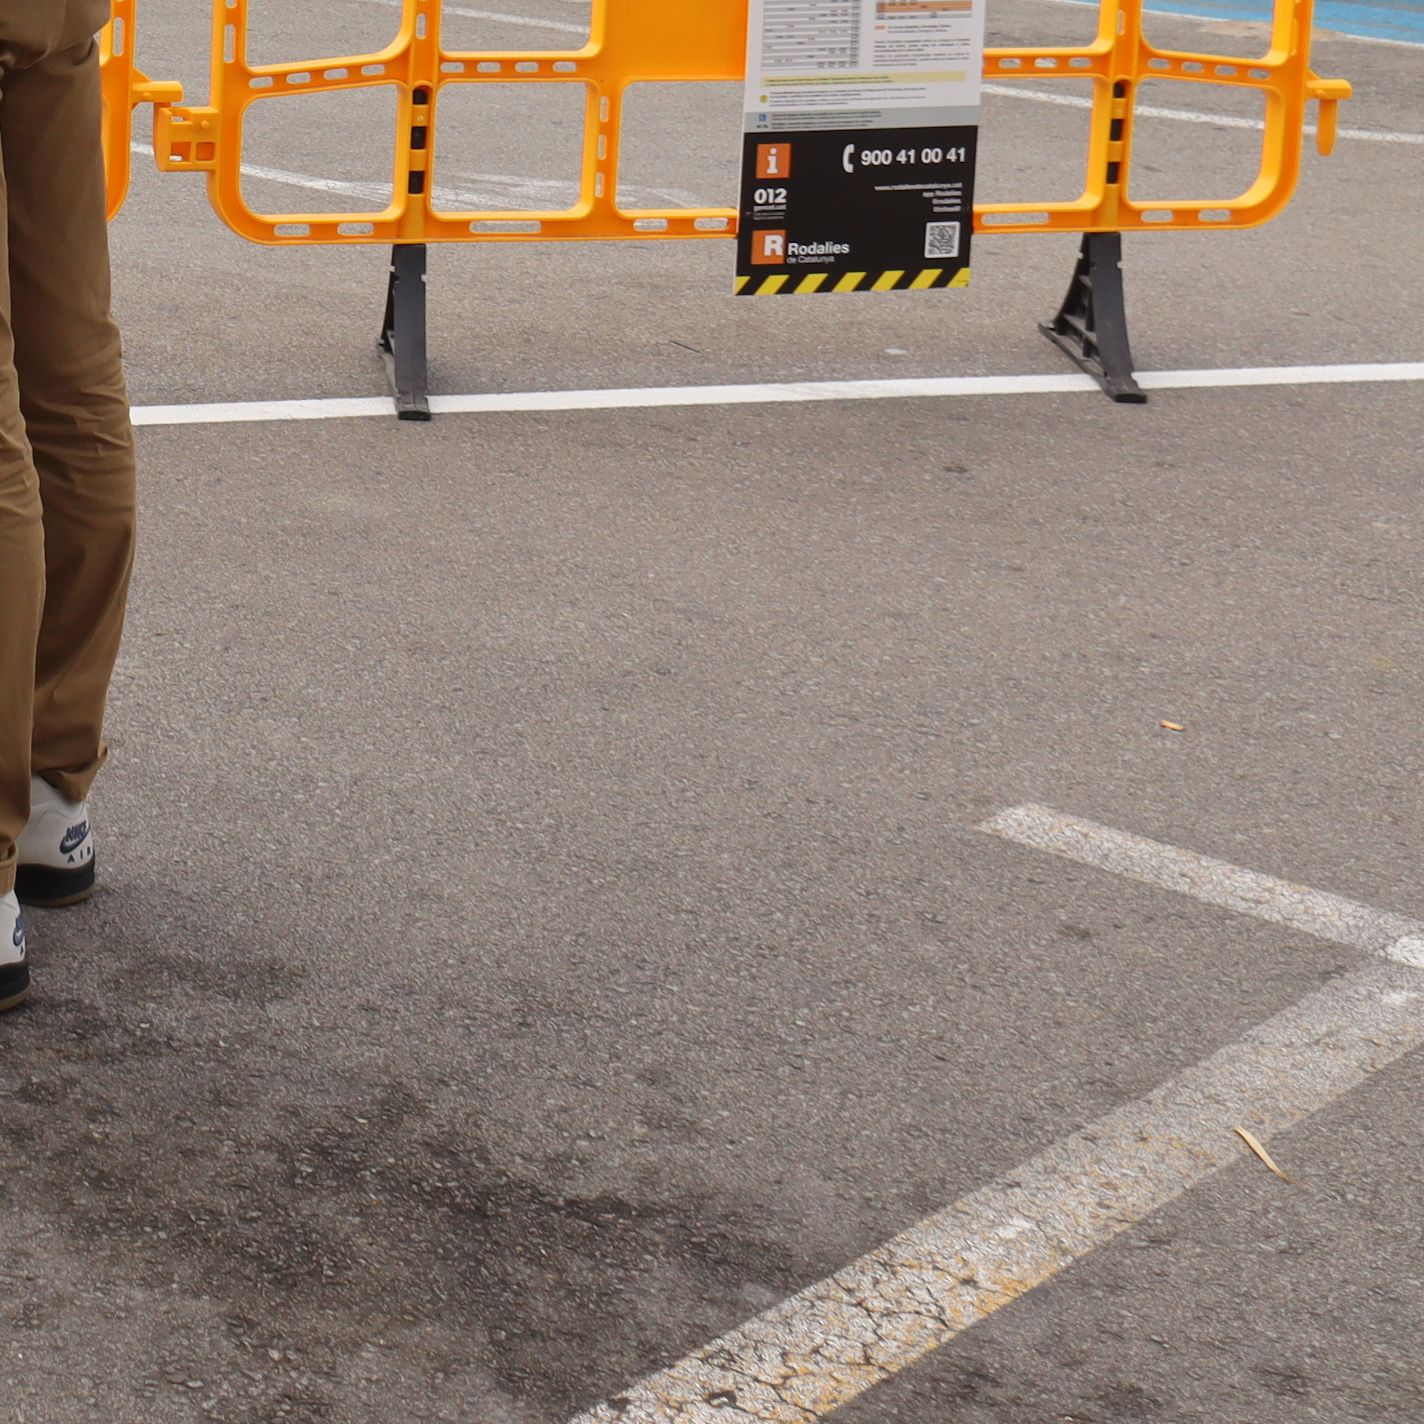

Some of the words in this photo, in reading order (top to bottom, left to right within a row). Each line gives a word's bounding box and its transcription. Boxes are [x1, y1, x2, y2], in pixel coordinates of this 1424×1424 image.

[860, 149, 892, 166] 900
[896, 148, 916, 164] 41
[920, 148, 942, 164] 00
[946, 147, 966, 162] 41
[754, 188, 788, 204] 012
[764, 234, 784, 256] R
[788, 241, 850, 256] Rodalies
